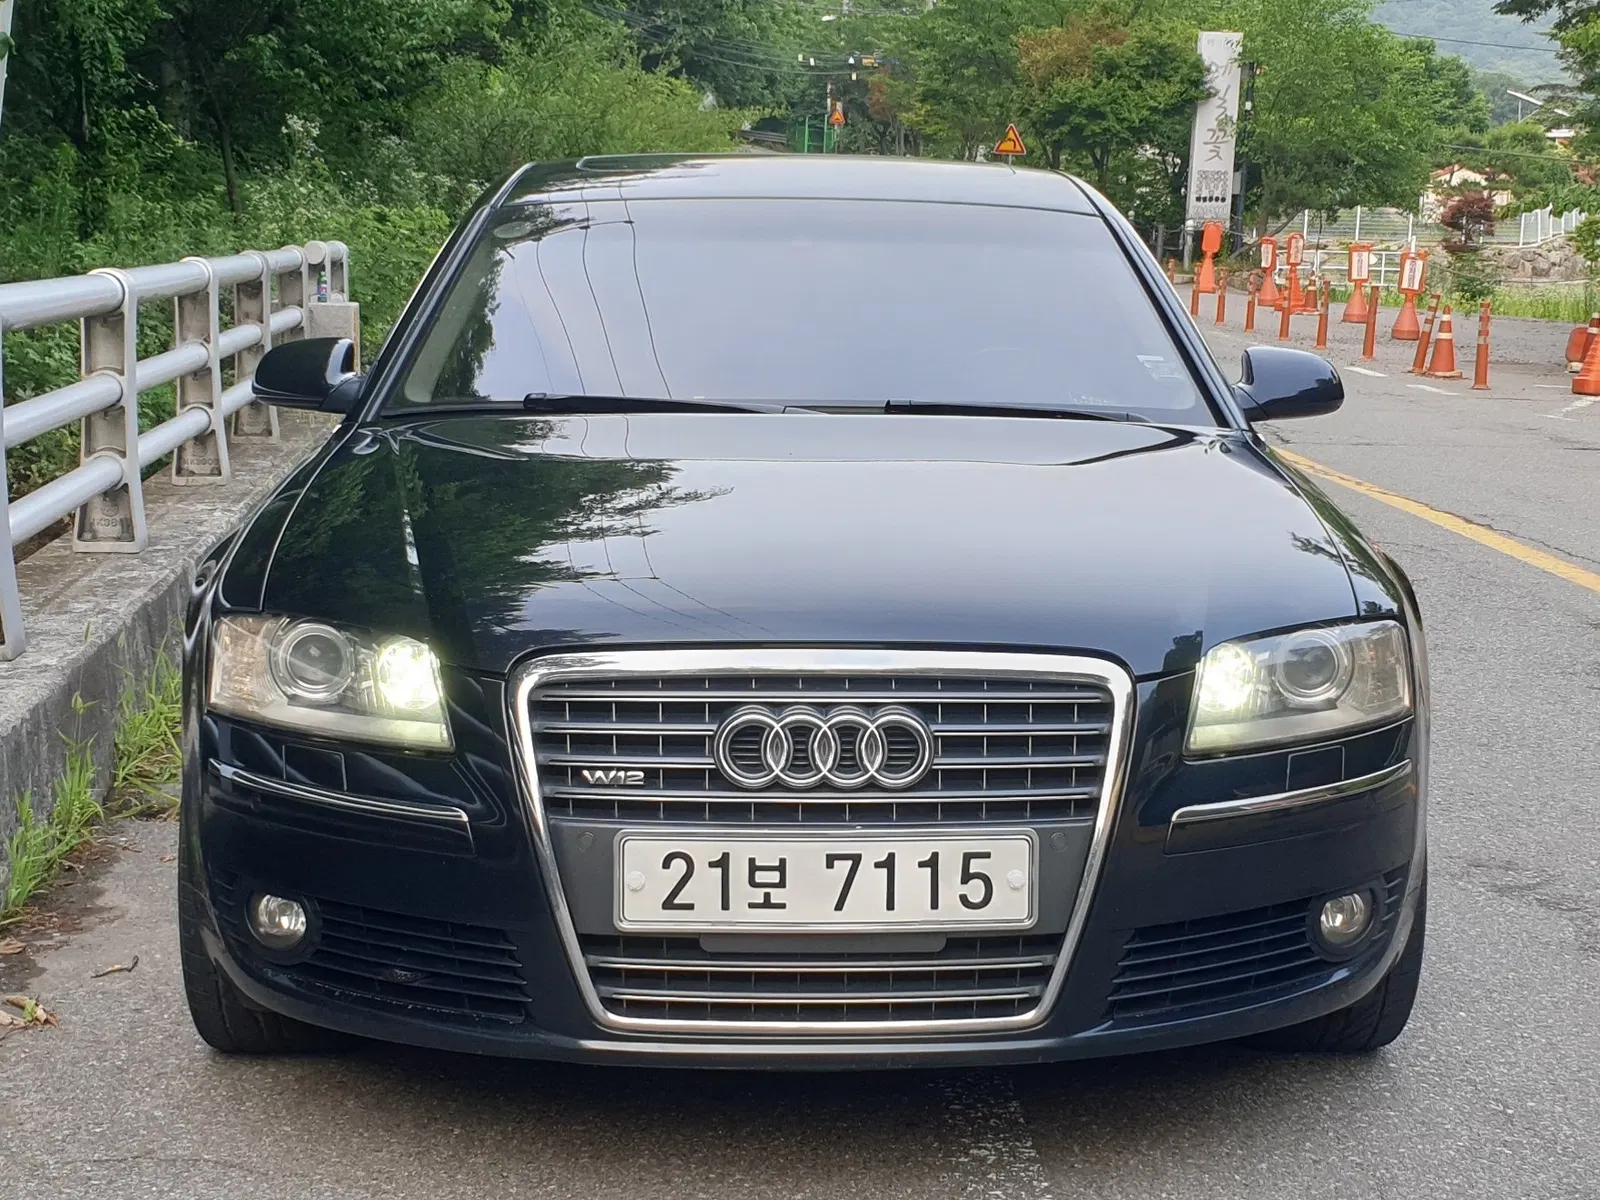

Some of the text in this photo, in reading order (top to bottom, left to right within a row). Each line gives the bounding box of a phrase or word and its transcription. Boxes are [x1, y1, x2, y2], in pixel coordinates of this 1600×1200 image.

[581, 769, 645, 785] W12
[661, 851, 994, 911] 21보 7115
